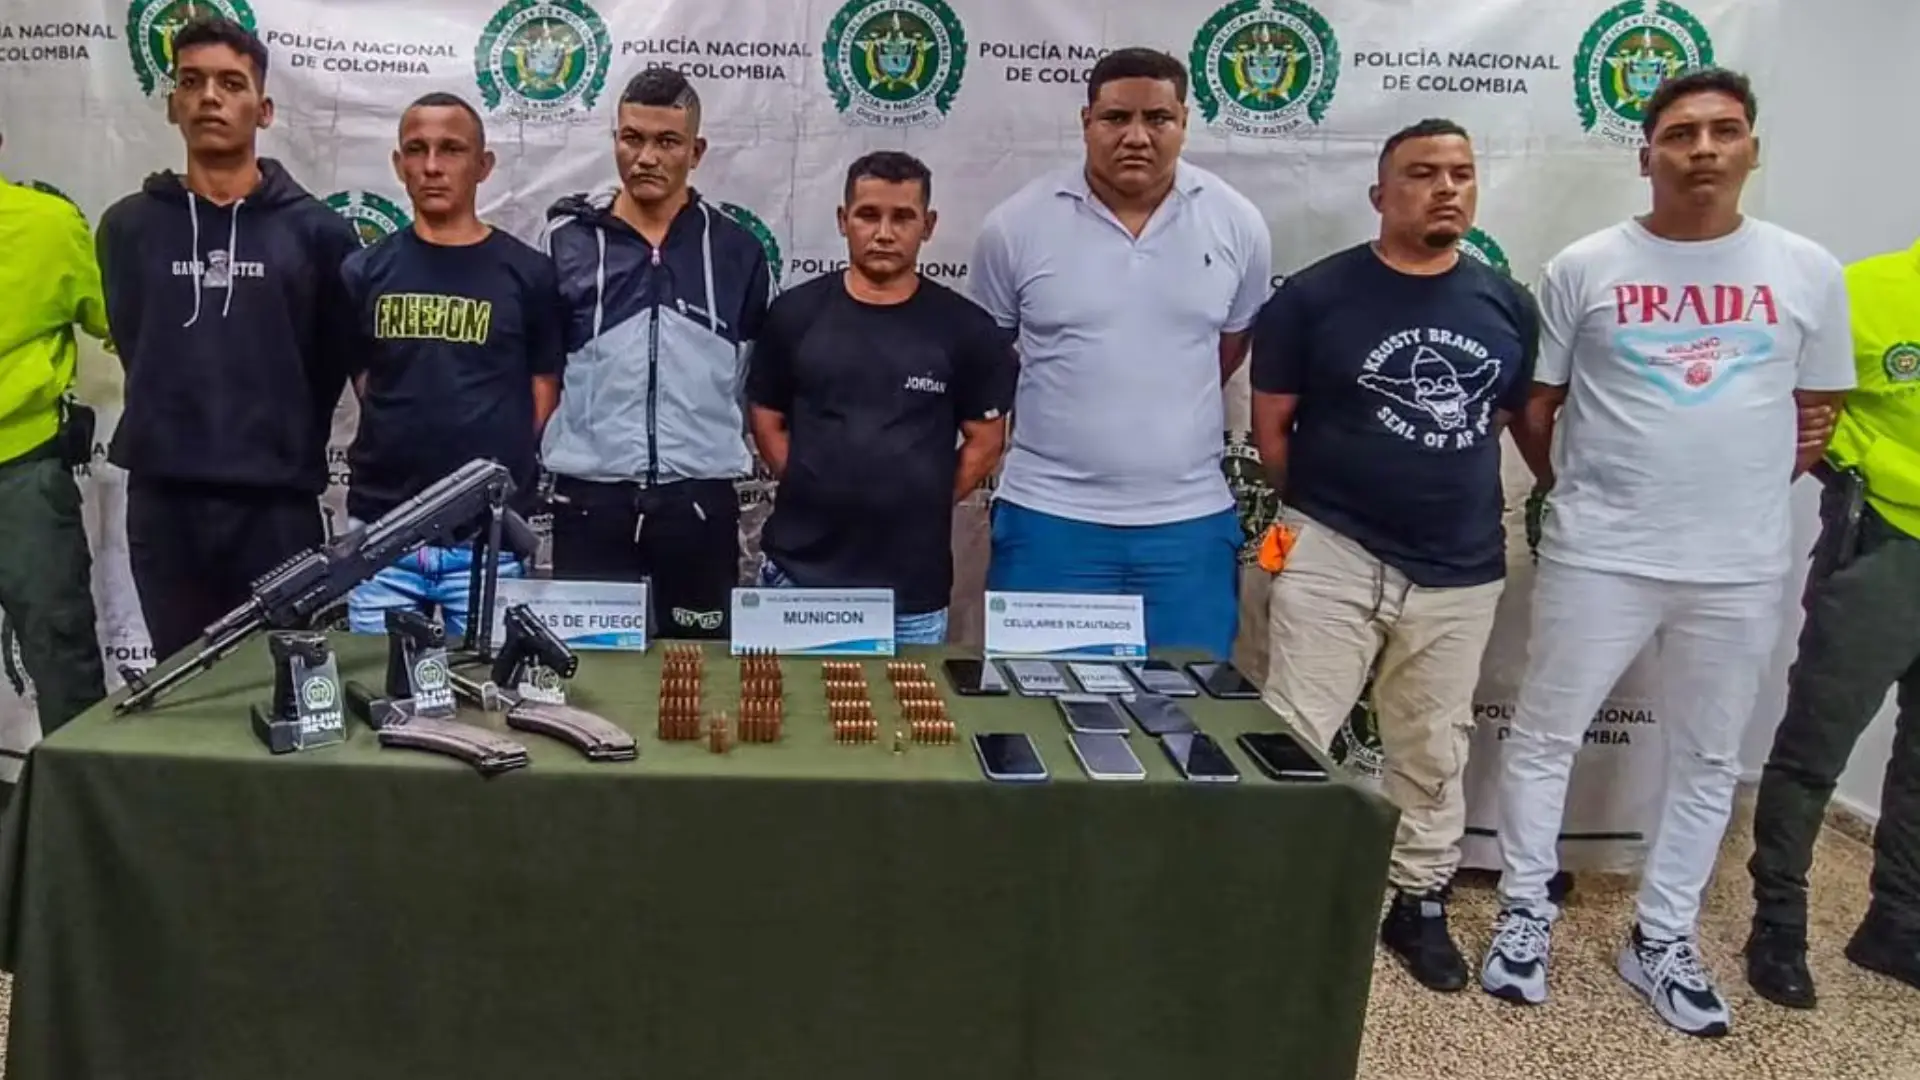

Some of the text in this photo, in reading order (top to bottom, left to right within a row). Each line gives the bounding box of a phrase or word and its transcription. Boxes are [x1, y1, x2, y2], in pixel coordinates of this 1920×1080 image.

[19, 22, 119, 41] NACIONAL
[353, 41, 459, 58] NACIONAL
[706, 41, 812, 58] NACIONAL
[291, 54, 430, 75] DE COLOMBIA
[1448, 52, 1560, 70] NACIONAL
[679, 62, 786, 80] COLOMBIA
[1006, 66, 1032, 82] DE
[1383, 74, 1528, 94] DE COLOMBIA
[1613, 284, 1778, 325] PRADA
[1363, 328, 1488, 372] KRUSTY BRAND
[904, 376, 947, 394] JORDAN
[1377, 406, 1449, 449] SEAL OF
[563, 615, 584, 628] DE
[783, 611, 864, 624] MUNICION
[1003, 618, 1132, 631] CELULARES INCAUTADOS
